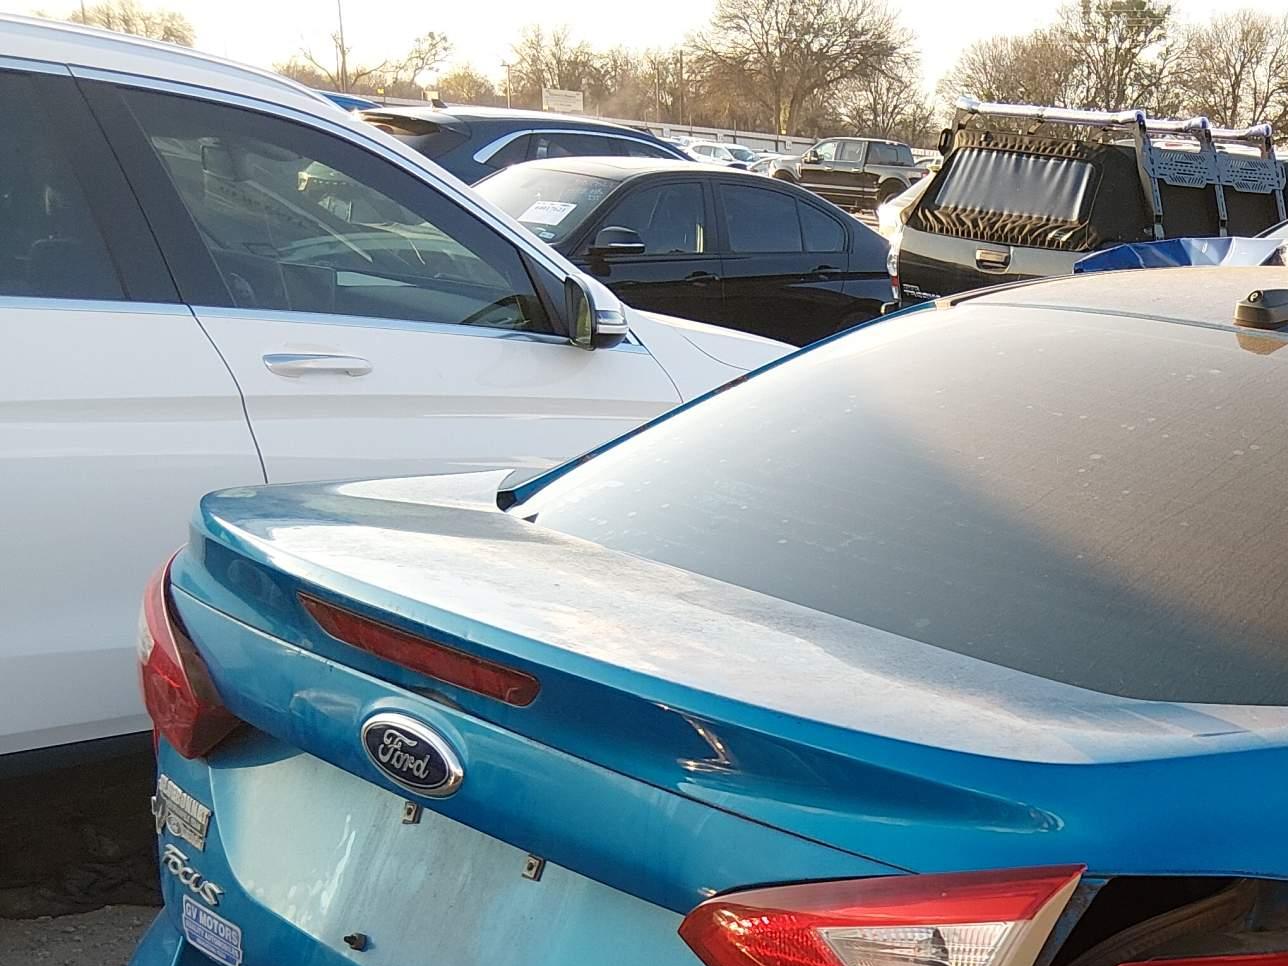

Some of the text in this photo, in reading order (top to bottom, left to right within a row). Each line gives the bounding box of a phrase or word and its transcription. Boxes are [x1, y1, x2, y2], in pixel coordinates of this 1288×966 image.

[378, 729, 431, 779] Ford
[185, 902, 239, 947] GV MOTORS
